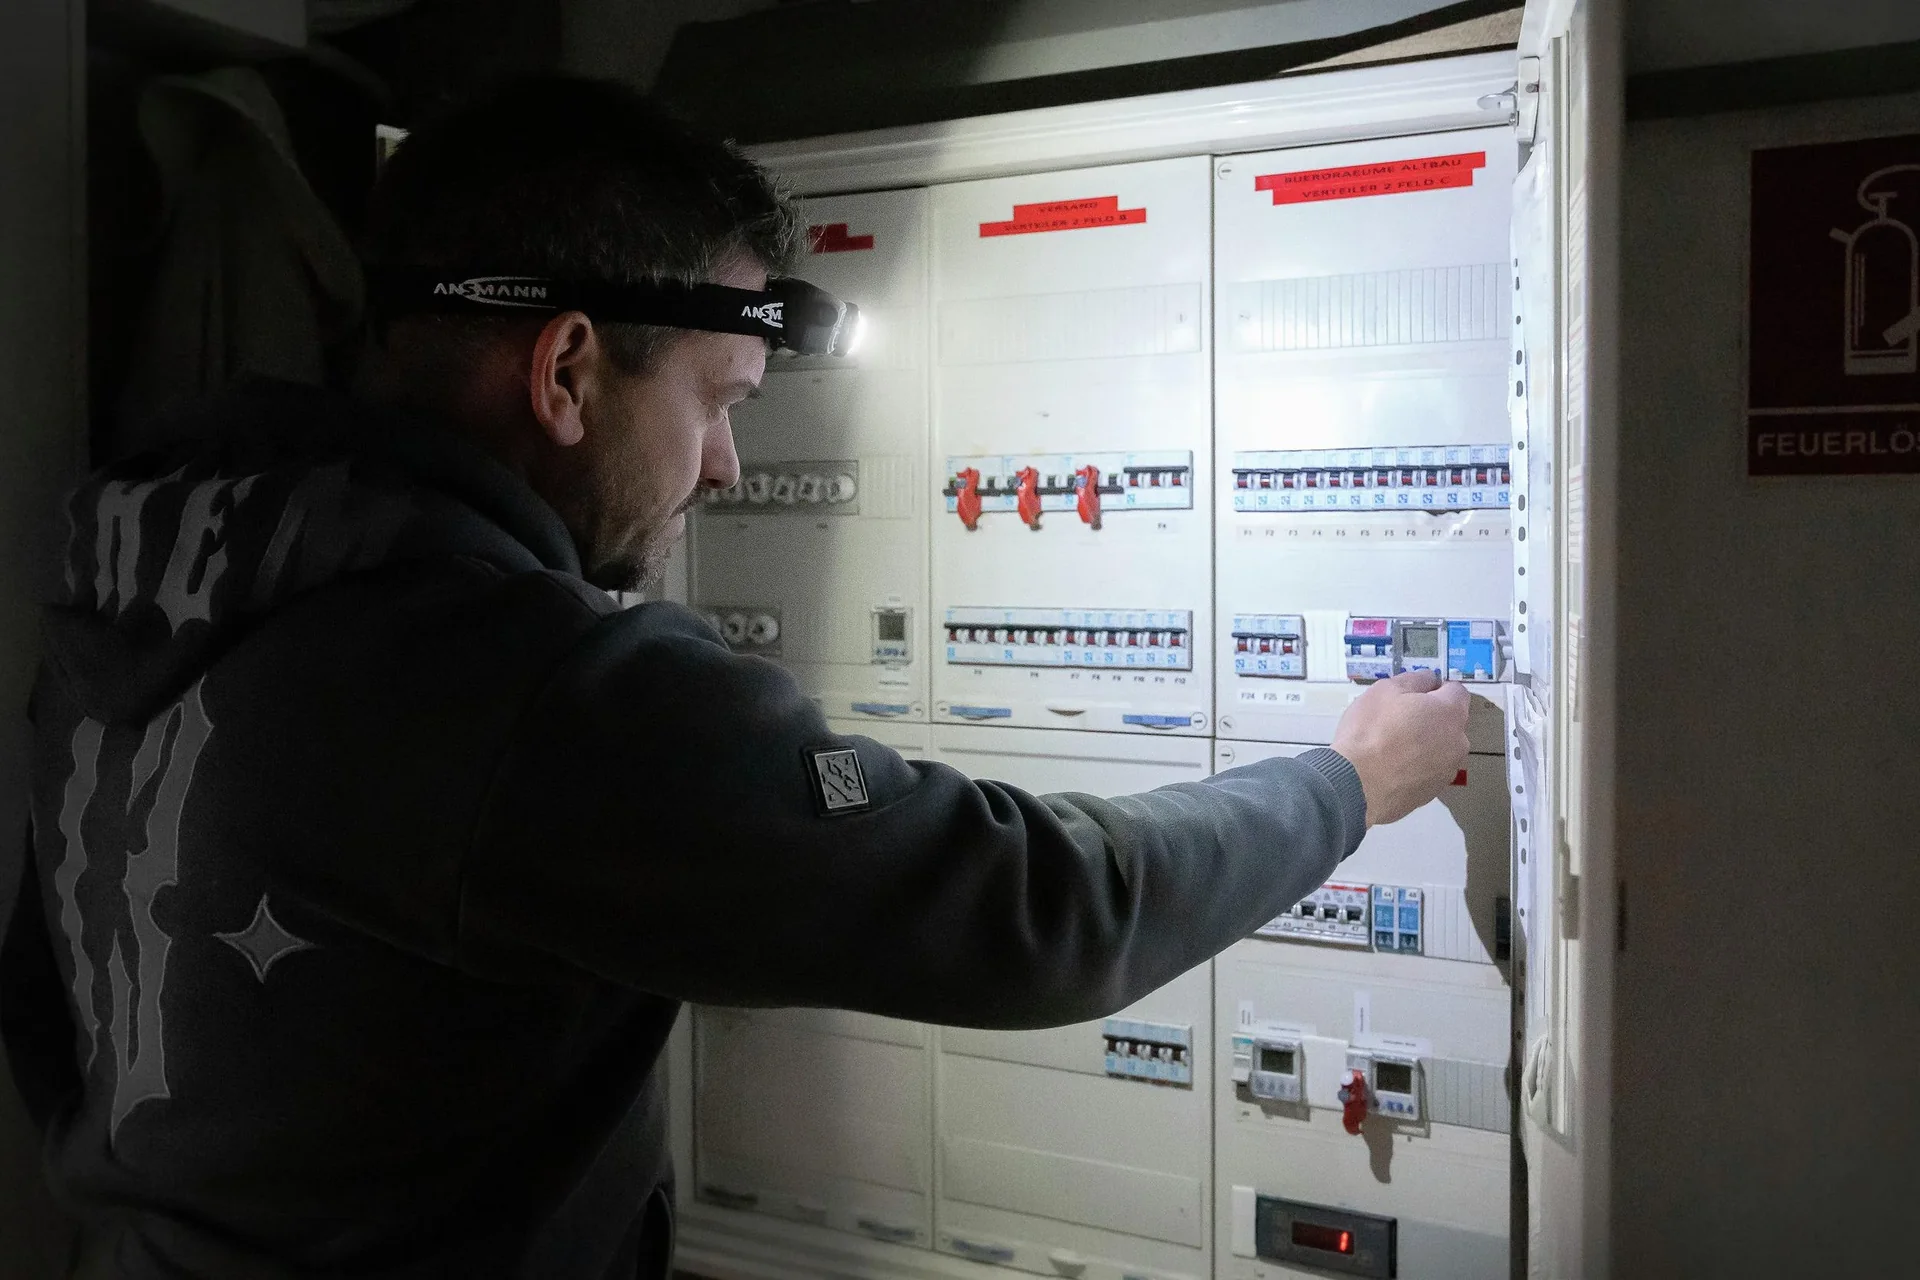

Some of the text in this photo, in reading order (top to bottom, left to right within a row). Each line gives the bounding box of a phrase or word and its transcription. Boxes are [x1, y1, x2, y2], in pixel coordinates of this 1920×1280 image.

[1401, 158, 1461, 171] ALTBAU
[1303, 176, 1452, 198] VERTEILER 2 FELD C
[434, 278, 552, 304] ANSMANN
[741, 303, 783, 325] ANSM
[1757, 422, 1920, 457] FEUERLÖ
[1340, 1231, 1349, 1252] 1
